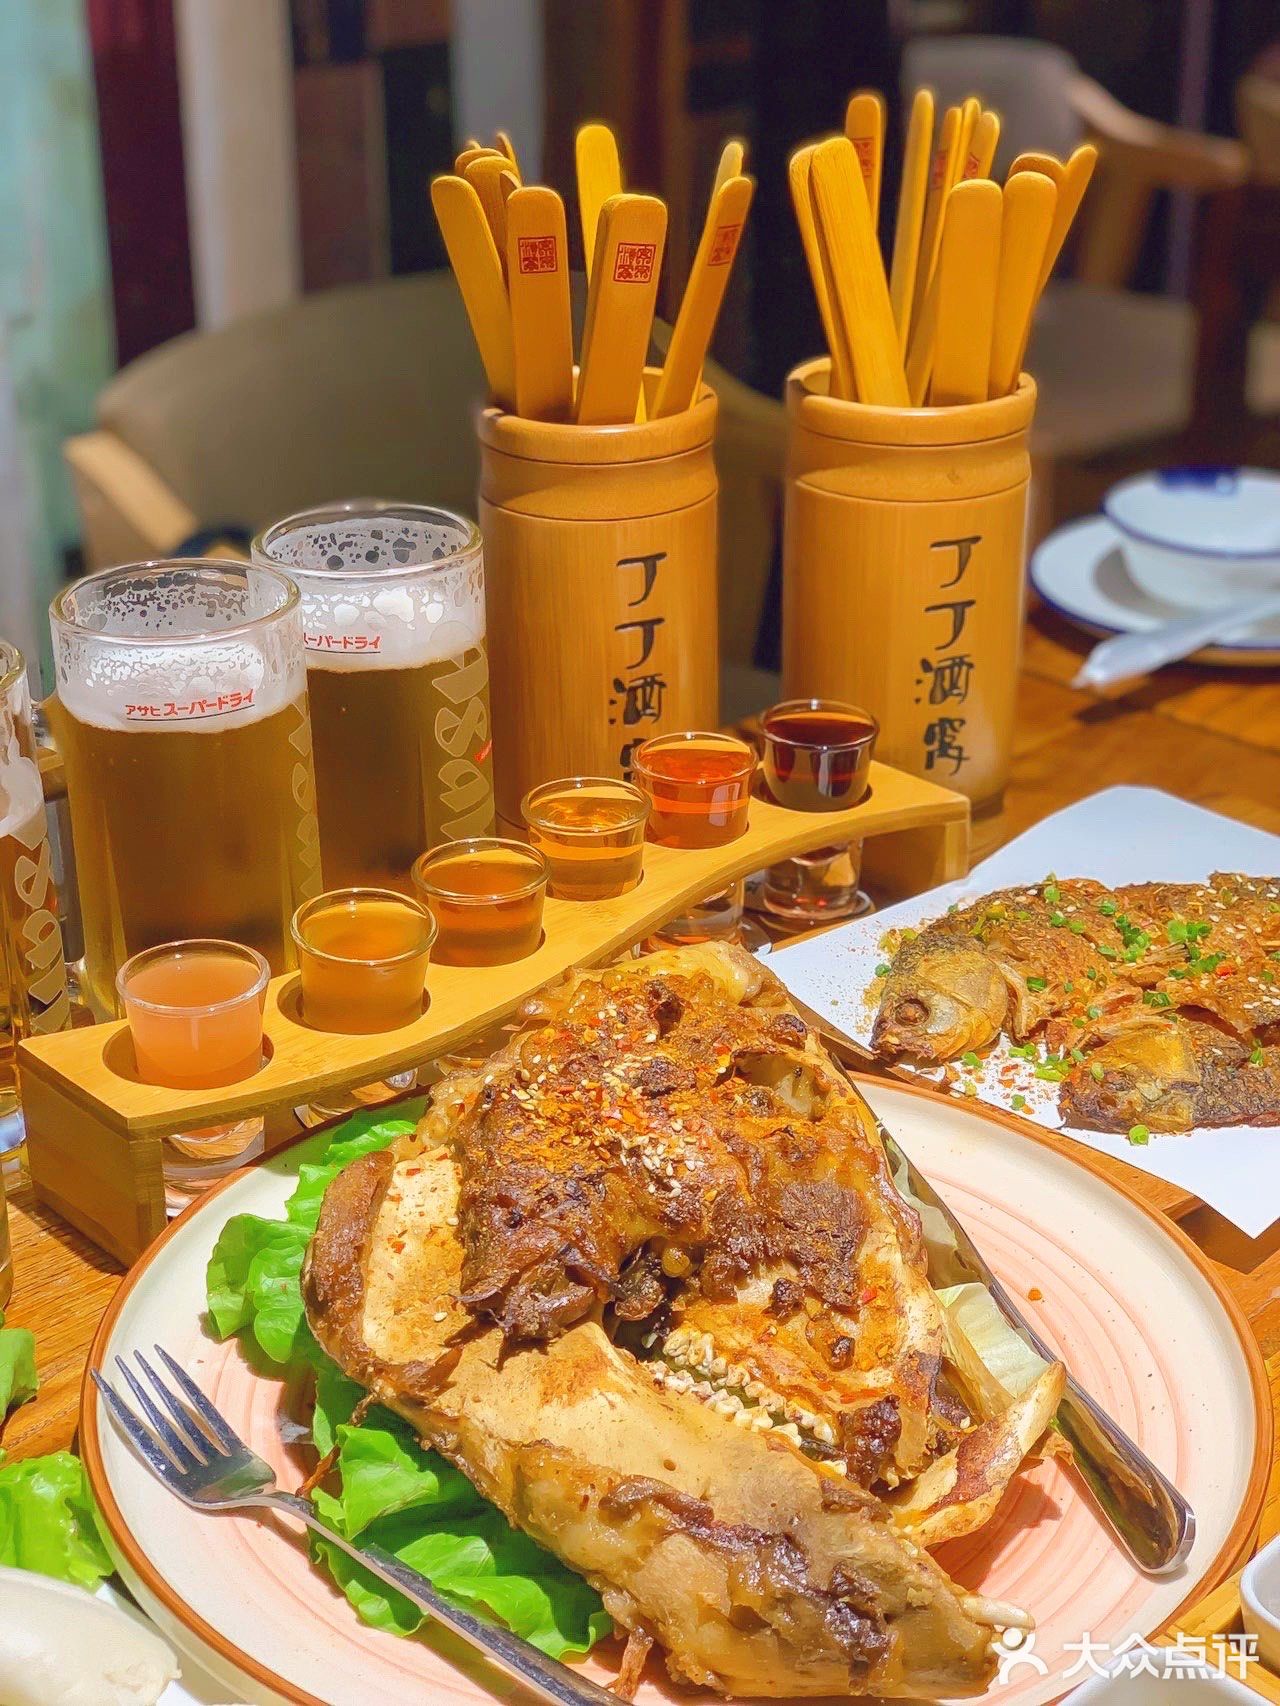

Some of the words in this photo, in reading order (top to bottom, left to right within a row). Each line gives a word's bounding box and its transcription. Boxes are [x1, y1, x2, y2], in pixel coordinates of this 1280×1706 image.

[125, 704, 161, 717] アサヒ
[163, 688, 255, 716] スーパードライ
